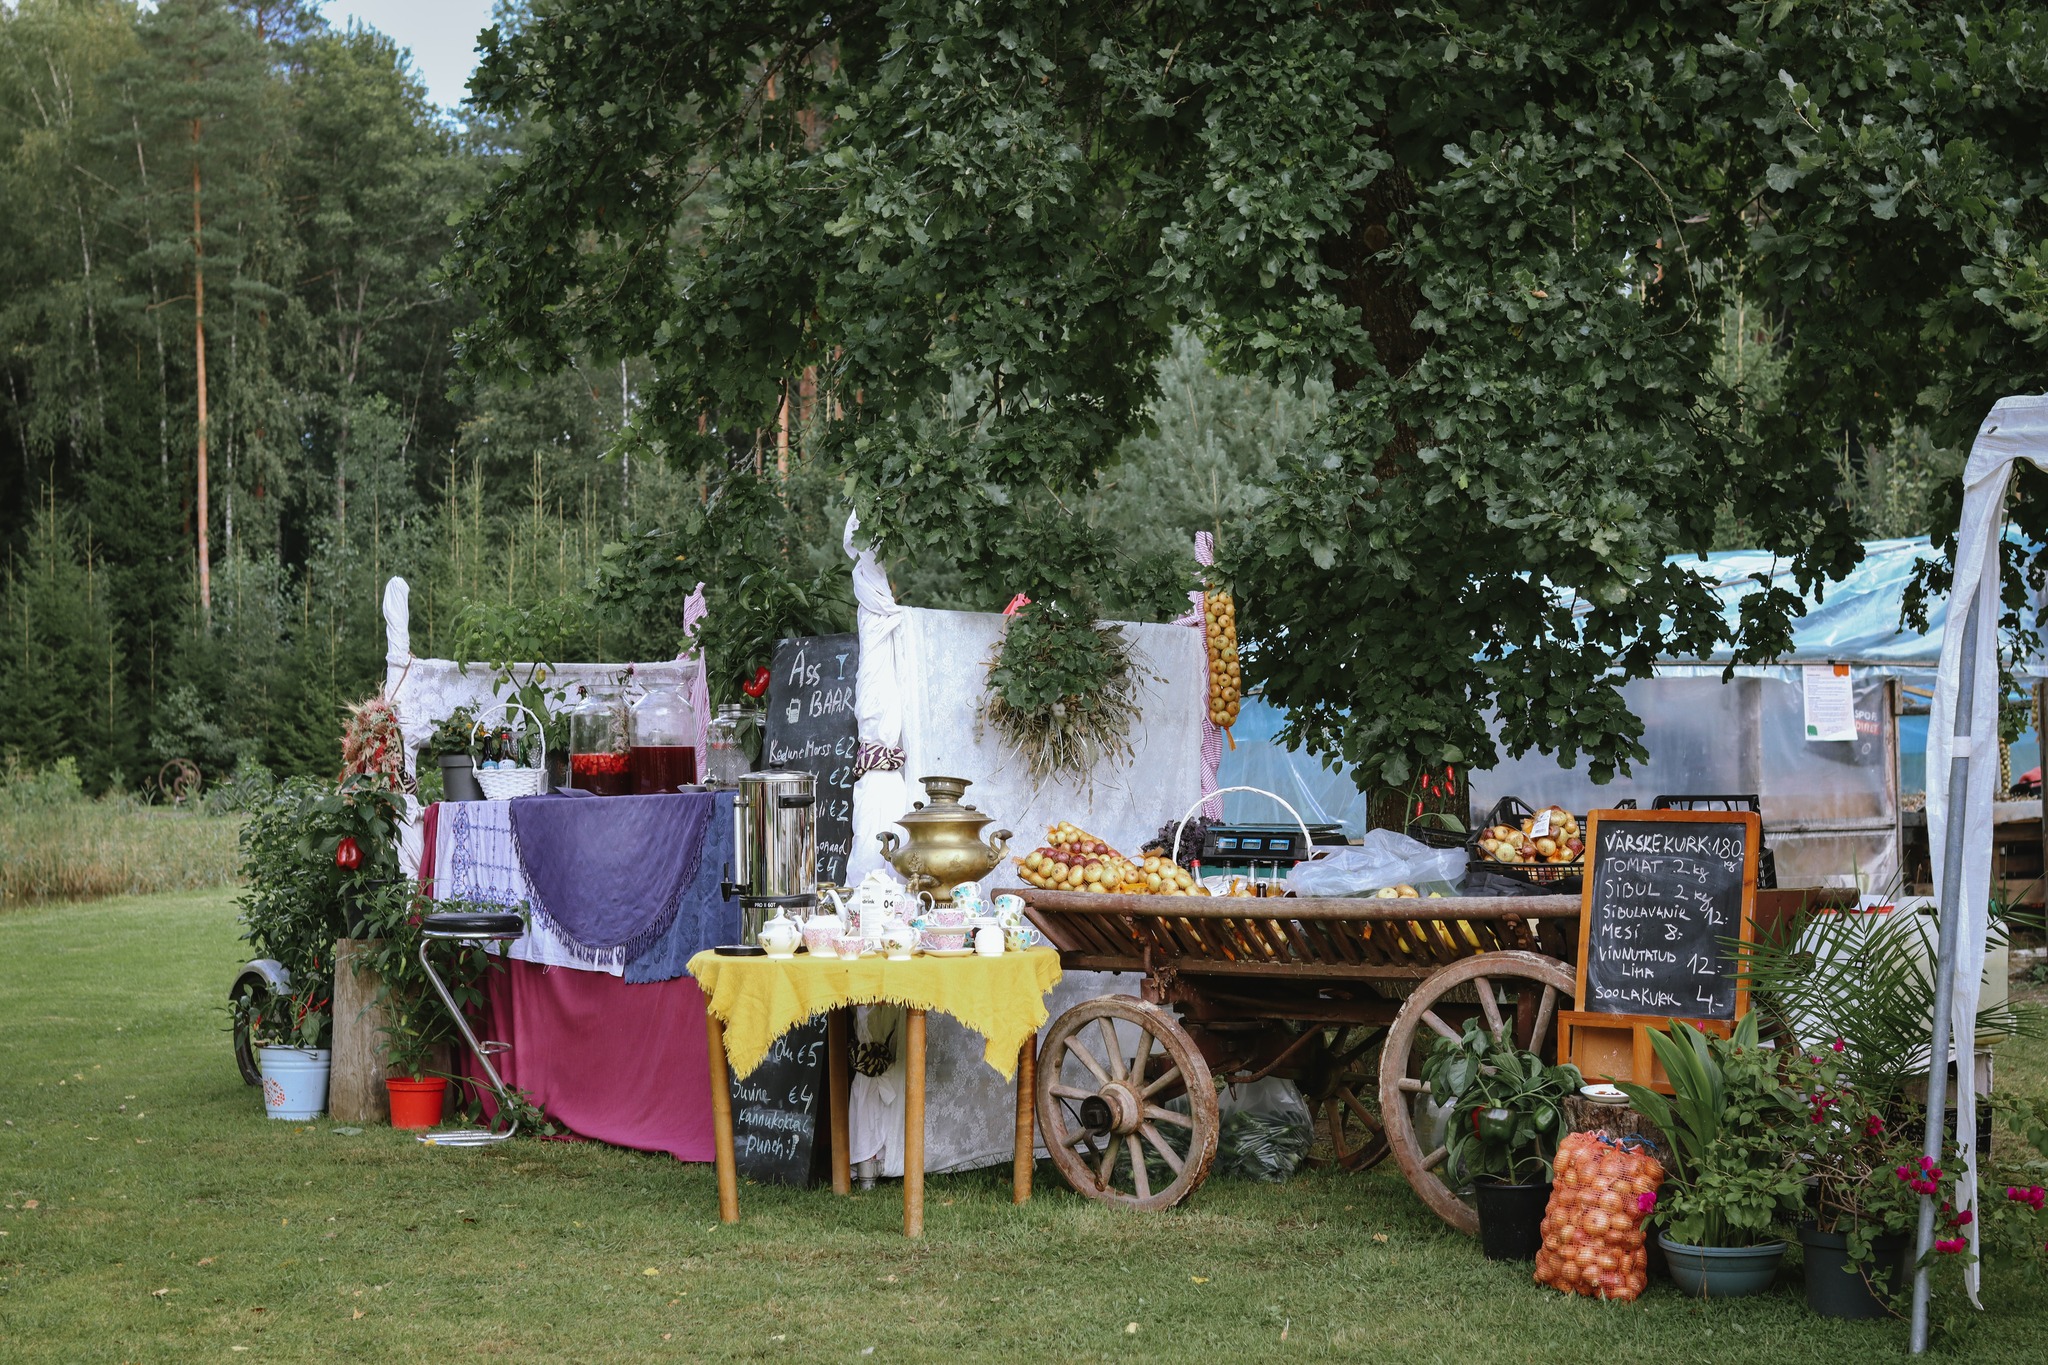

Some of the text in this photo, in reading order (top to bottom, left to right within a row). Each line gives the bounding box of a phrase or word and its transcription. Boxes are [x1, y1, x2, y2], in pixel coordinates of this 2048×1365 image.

[788, 641, 822, 688] Äss
[808, 686, 855, 718] BAAR
[829, 765, 852, 788] €2
[829, 799, 849, 822] €2
[1605, 857, 1663, 874] TOMAT
[1692, 864, 1710, 884] kg
[1674, 884, 1689, 901] 2
[1694, 890, 1714, 912] kg
[788, 1084, 813, 1115] €4
